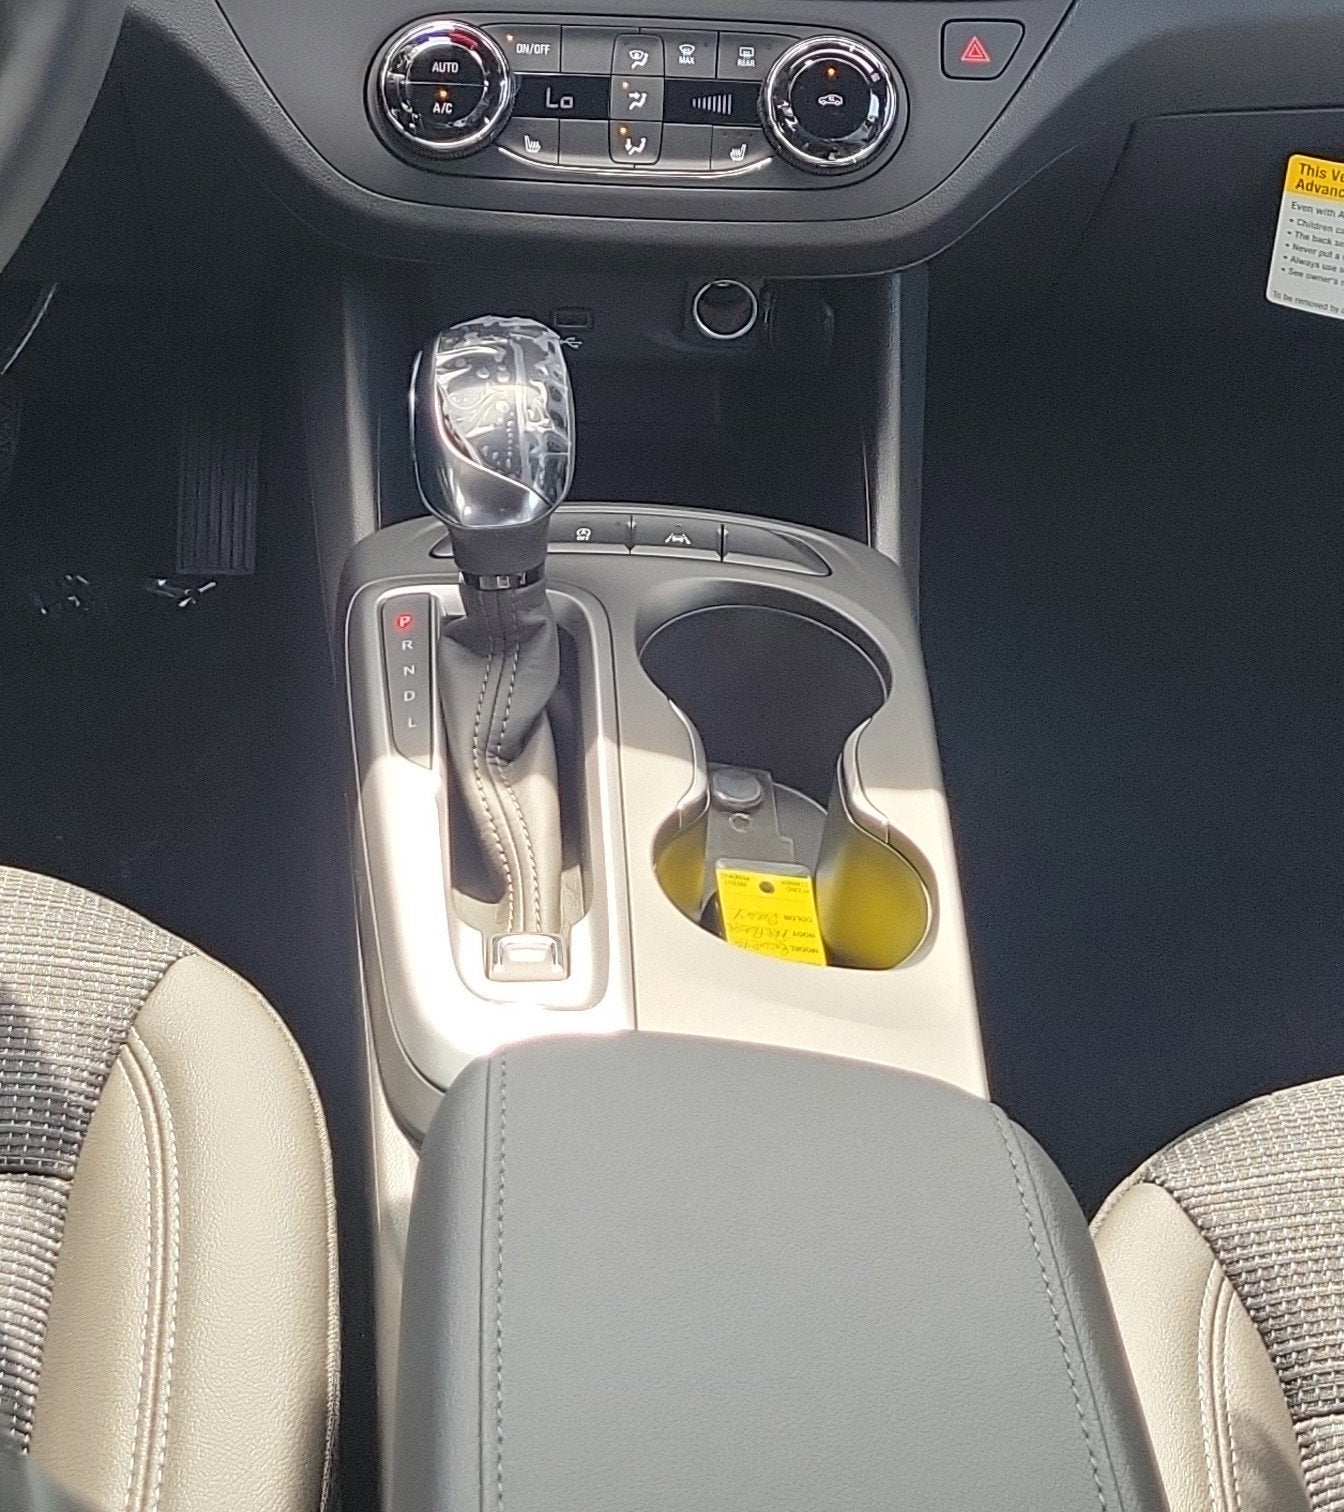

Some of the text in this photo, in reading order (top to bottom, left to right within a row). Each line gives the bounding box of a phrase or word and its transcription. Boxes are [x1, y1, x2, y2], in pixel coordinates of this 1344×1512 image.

[516, 43, 550, 56] ON/OFF
[432, 61, 459, 74] AUTO
[432, 102, 453, 115] A/C
[1299, 163, 1327, 179] This
[1291, 201, 1313, 213] Even
[1316, 207, 1336, 218] with
[1297, 218, 1333, 232] Children
[1295, 231, 1310, 240] The
[1312, 233, 1332, 245] back
[1293, 243, 1316, 255] Never
[1319, 250, 1332, 259] put
[1290, 255, 1319, 269] Always
[1322, 264, 1337, 272] use
[1288, 268, 1304, 278] See
[1294, 297, 1328, 310] removed
[399, 615, 411, 628] P
[402, 640, 413, 650] R
[403, 665, 415, 676] N
[404, 690, 415, 701] D
[408, 717, 417, 728] L
